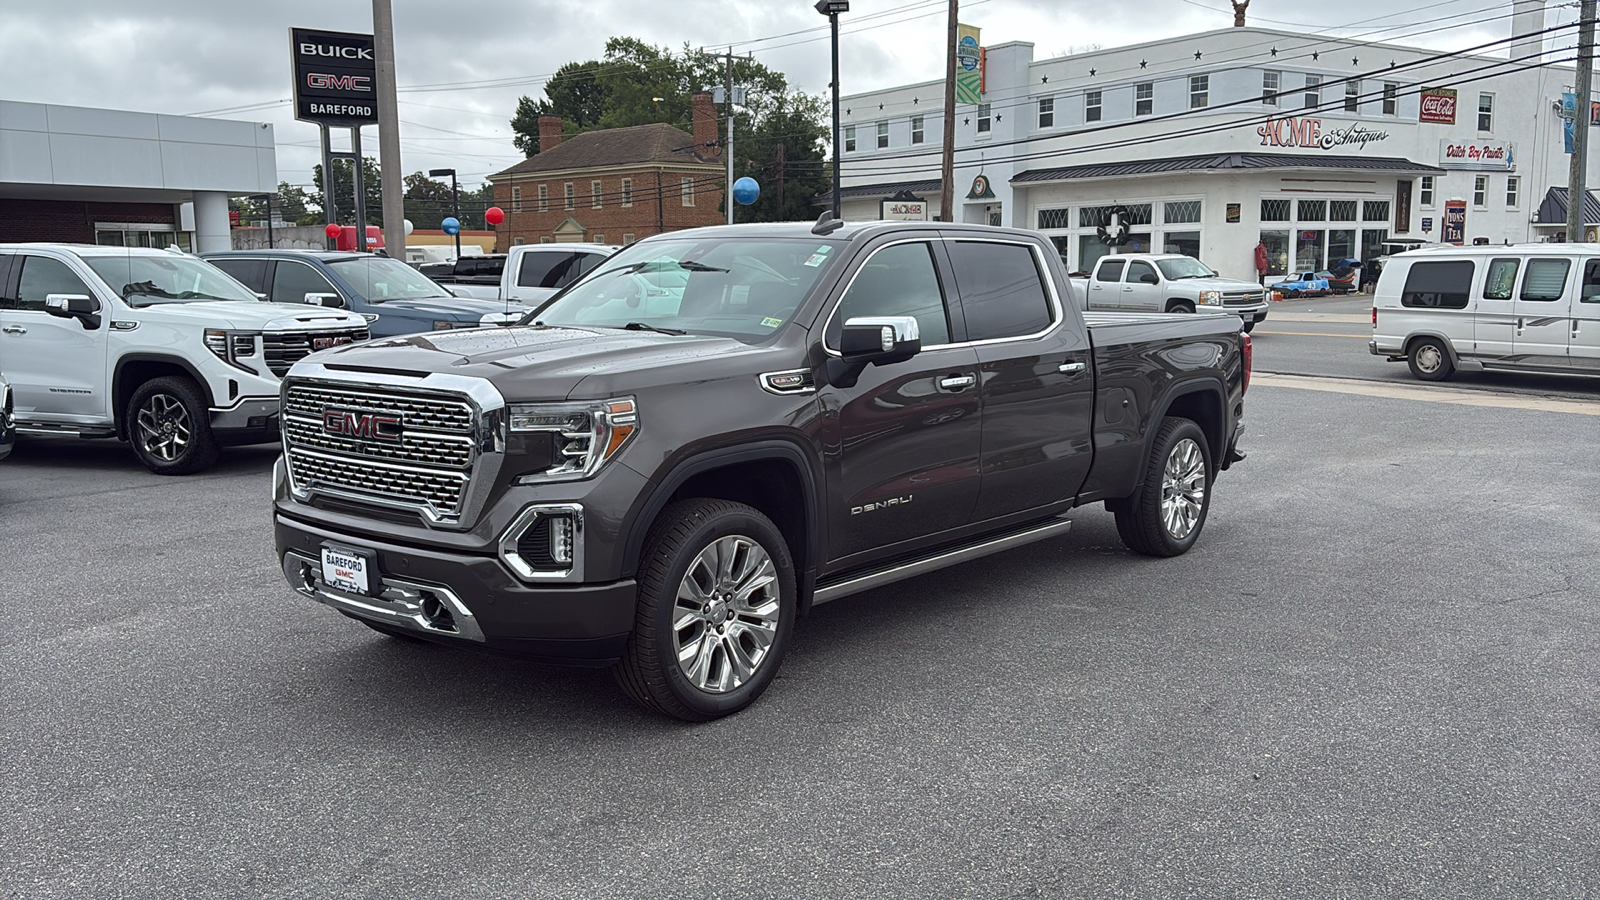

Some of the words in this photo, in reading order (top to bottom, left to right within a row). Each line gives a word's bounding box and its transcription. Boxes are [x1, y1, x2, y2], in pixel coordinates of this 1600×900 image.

[300, 43, 374, 60] BUICK
[307, 72, 371, 92] GMC
[310, 103, 372, 116] BAREFORD
[1257, 115, 1321, 148] ACME
[1335, 121, 1389, 150] Antiques
[1446, 144, 1466, 158] Dutch
[1468, 145, 1482, 161] Boy
[1482, 146, 1504, 159] Paints
[890, 204, 922, 214] ACME
[1448, 228, 1461, 240] TEA
[314, 336, 351, 349] GM
[323, 410, 400, 441] GMC
[850, 494, 913, 516] DENALI
[326, 554, 363, 572] BAREFORD
[335, 568, 354, 579] GMC
